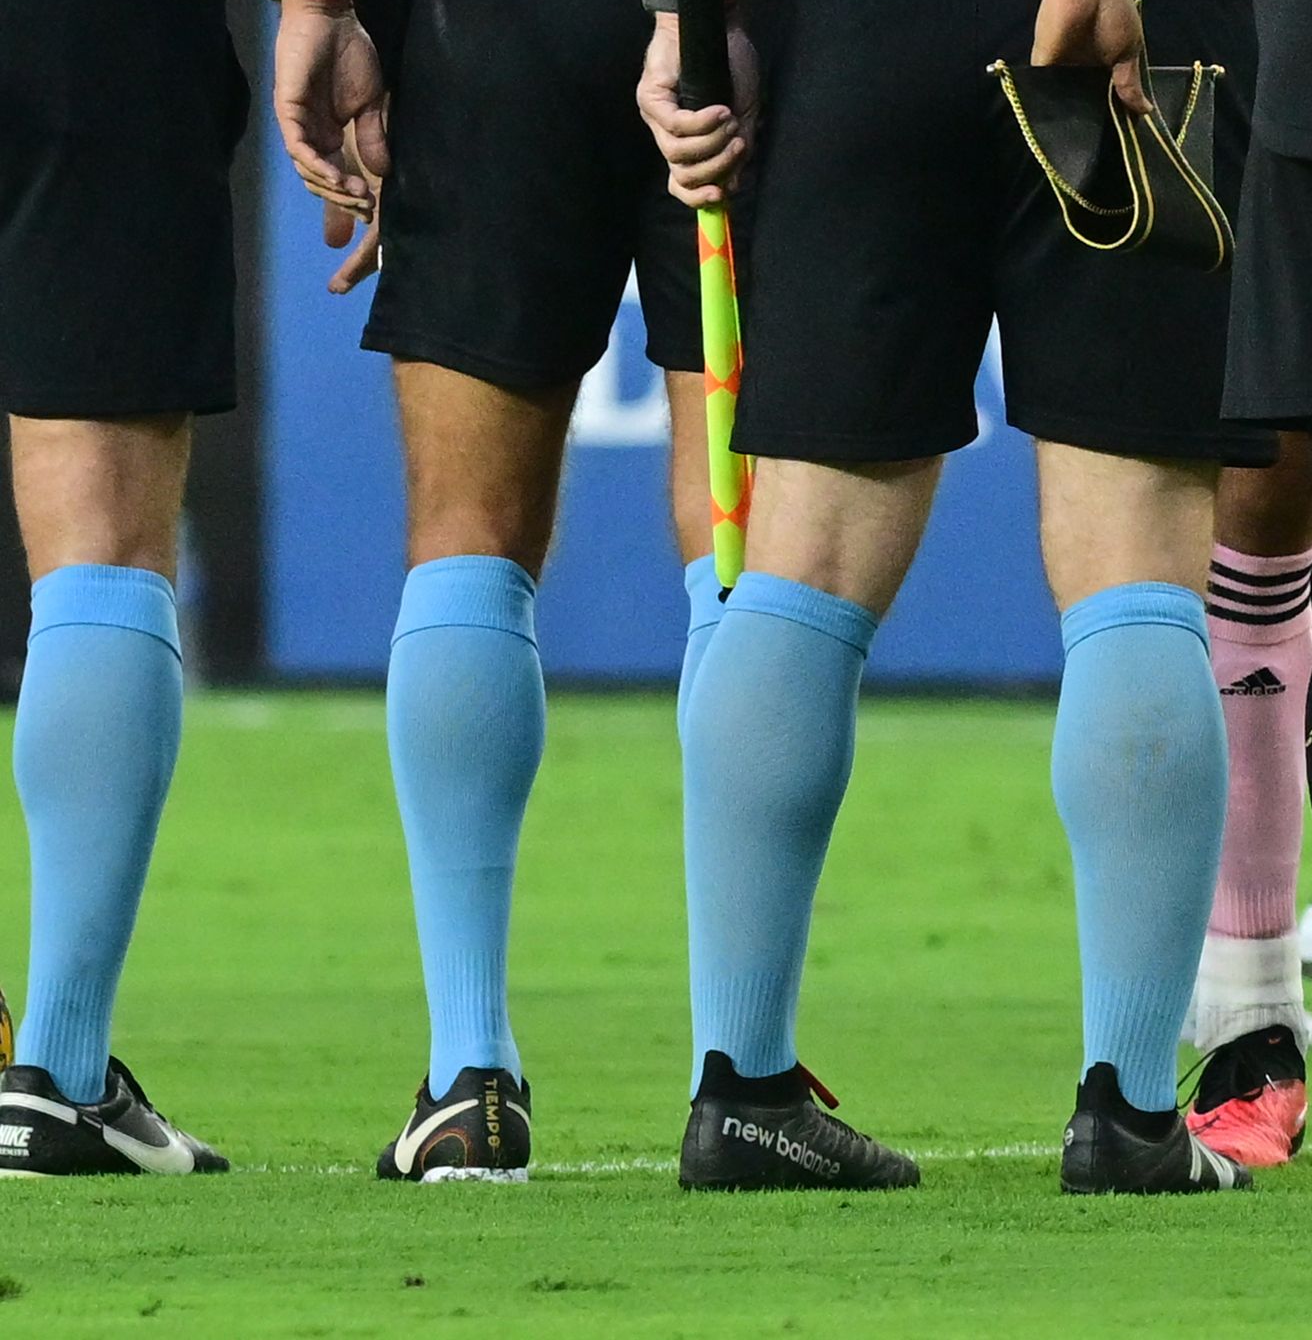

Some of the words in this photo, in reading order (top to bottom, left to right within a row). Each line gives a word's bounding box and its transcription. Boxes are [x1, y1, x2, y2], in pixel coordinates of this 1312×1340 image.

[484, 1077, 501, 1149] TIEMPO
[722, 1116, 775, 1149] new
[775, 1129, 841, 1180] balance
